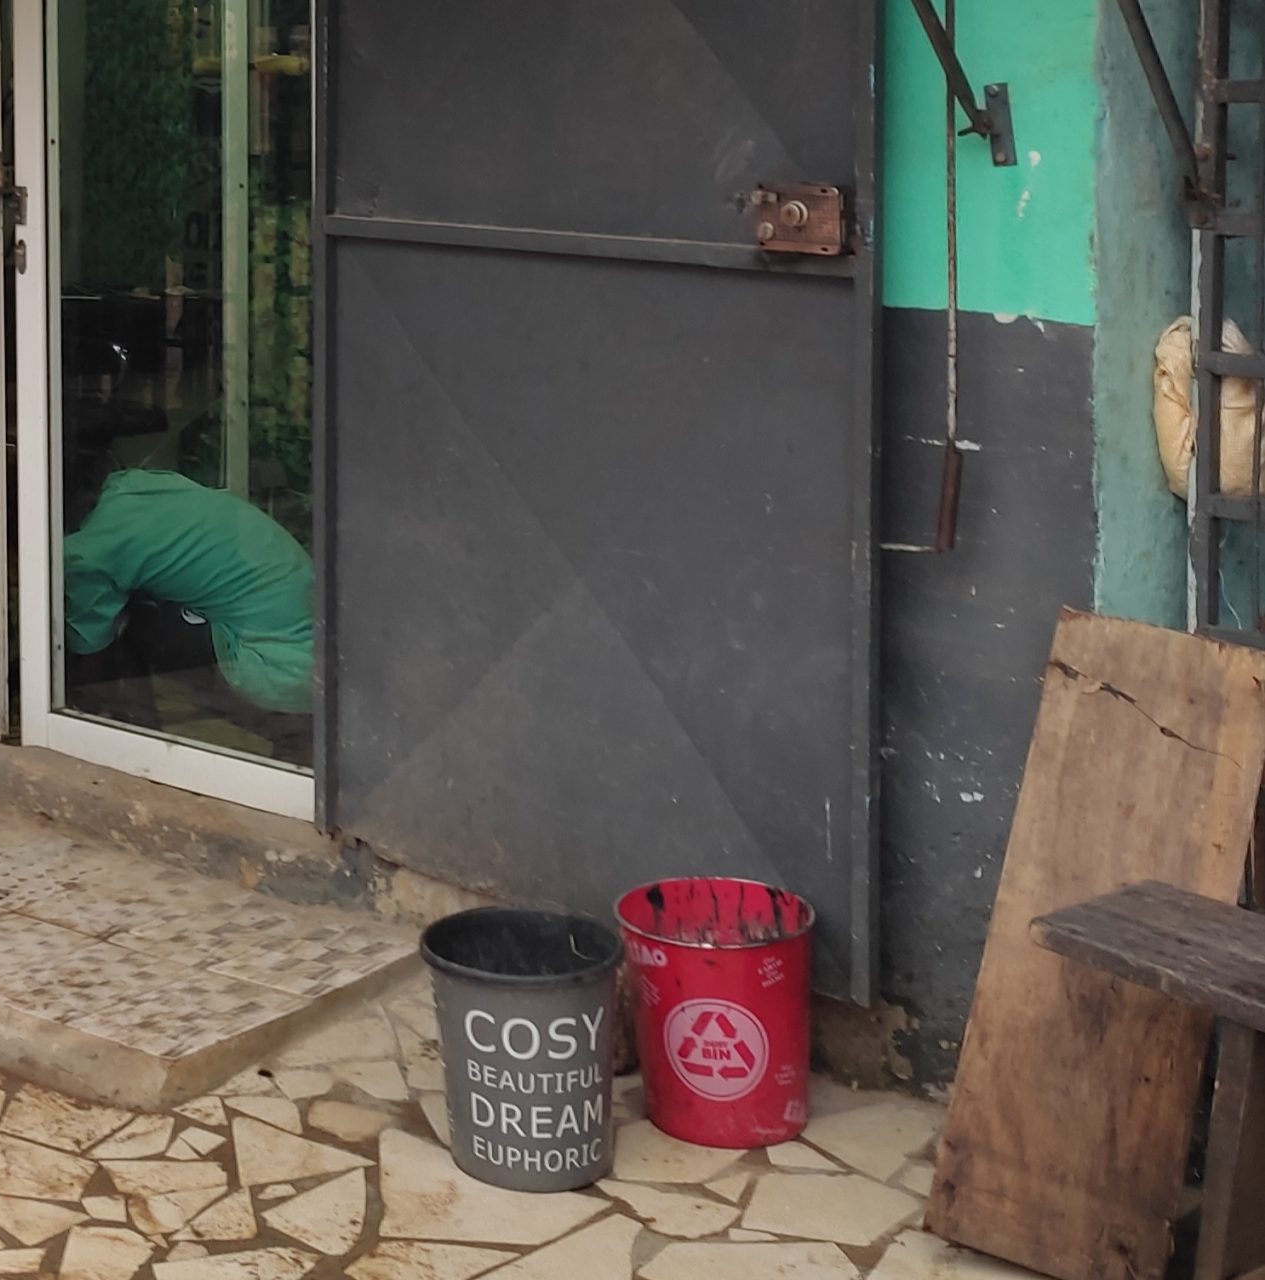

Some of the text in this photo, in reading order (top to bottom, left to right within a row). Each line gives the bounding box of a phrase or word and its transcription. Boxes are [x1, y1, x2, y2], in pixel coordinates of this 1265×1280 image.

[464, 1006, 604, 1060] COSY
[702, 1047, 731, 1060] BIN
[467, 1058, 602, 1095] BEAUTIFUL
[470, 1091, 603, 1139] DREAM
[472, 1135, 602, 1173] EUPHORIC
